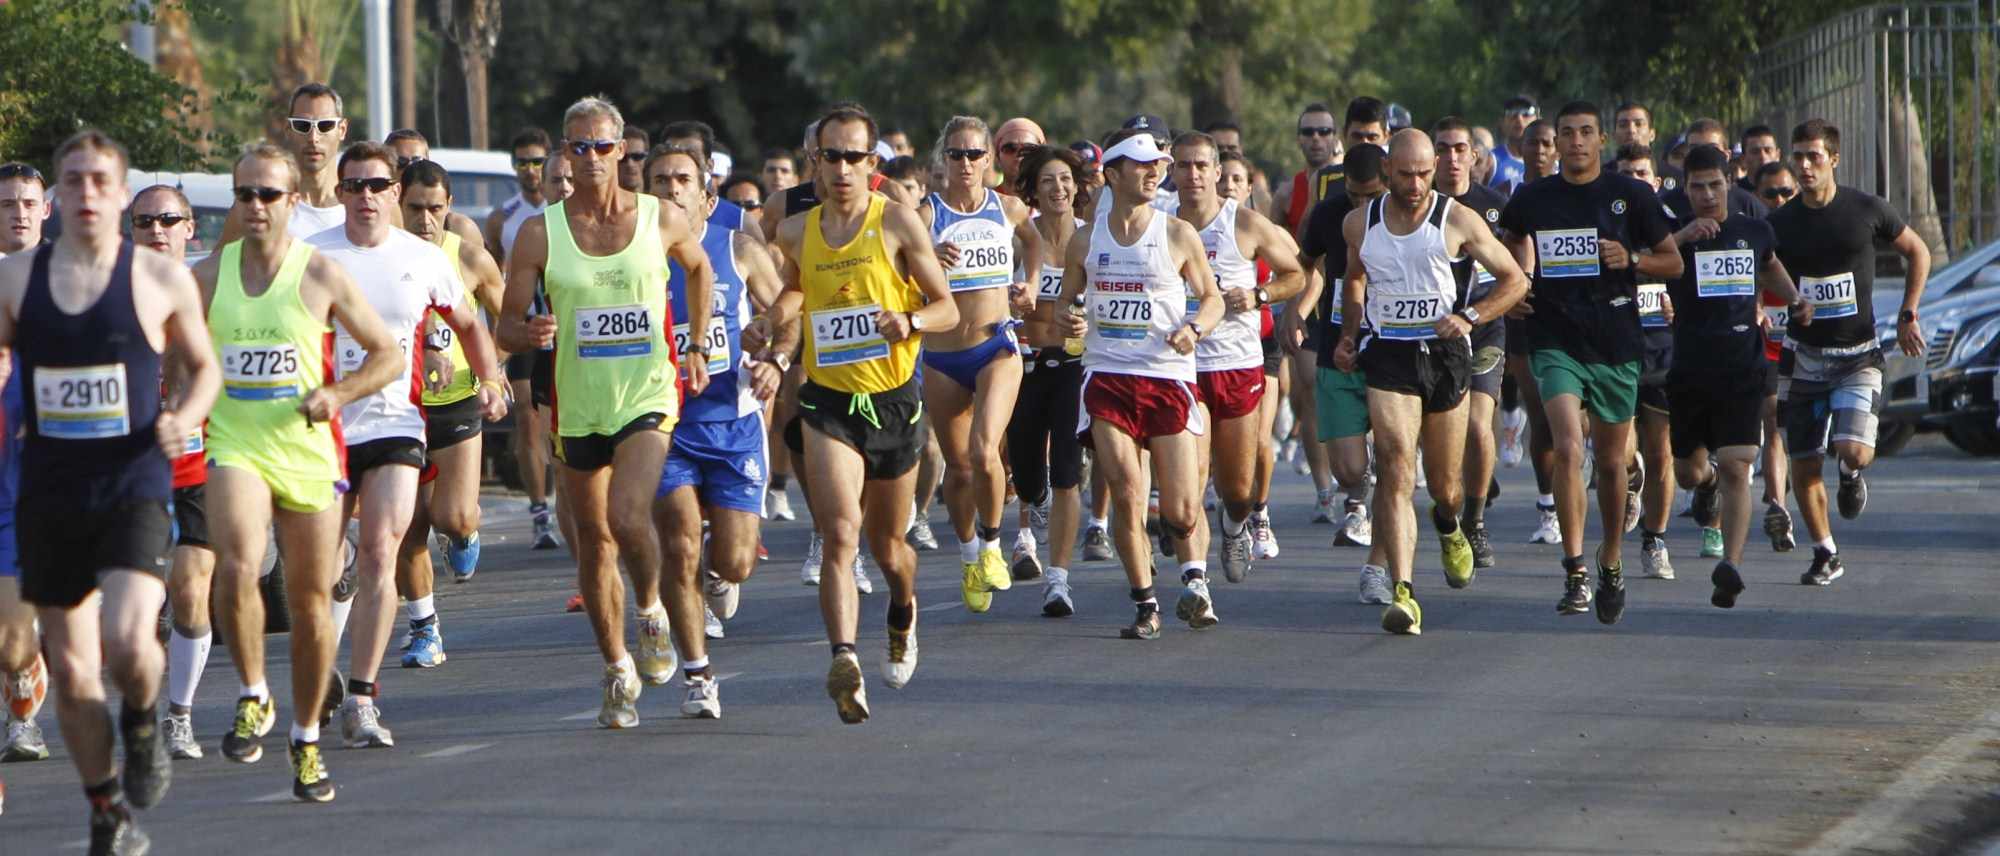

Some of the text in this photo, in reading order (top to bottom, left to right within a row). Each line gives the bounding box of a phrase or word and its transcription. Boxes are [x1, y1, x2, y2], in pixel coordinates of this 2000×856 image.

[1553, 236, 1597, 256] 2535
[964, 246, 1007, 268] 2686
[1714, 257, 1753, 276] 2652
[1638, 291, 1664, 308] 301
[1815, 280, 1851, 301] 3017
[1109, 300, 1152, 320] 2778
[1395, 299, 1439, 319] 2787
[597, 311, 650, 335] 2864
[831, 311, 881, 340] 2707
[240, 349, 296, 375] 2725
[60, 378, 120, 407] 2910
